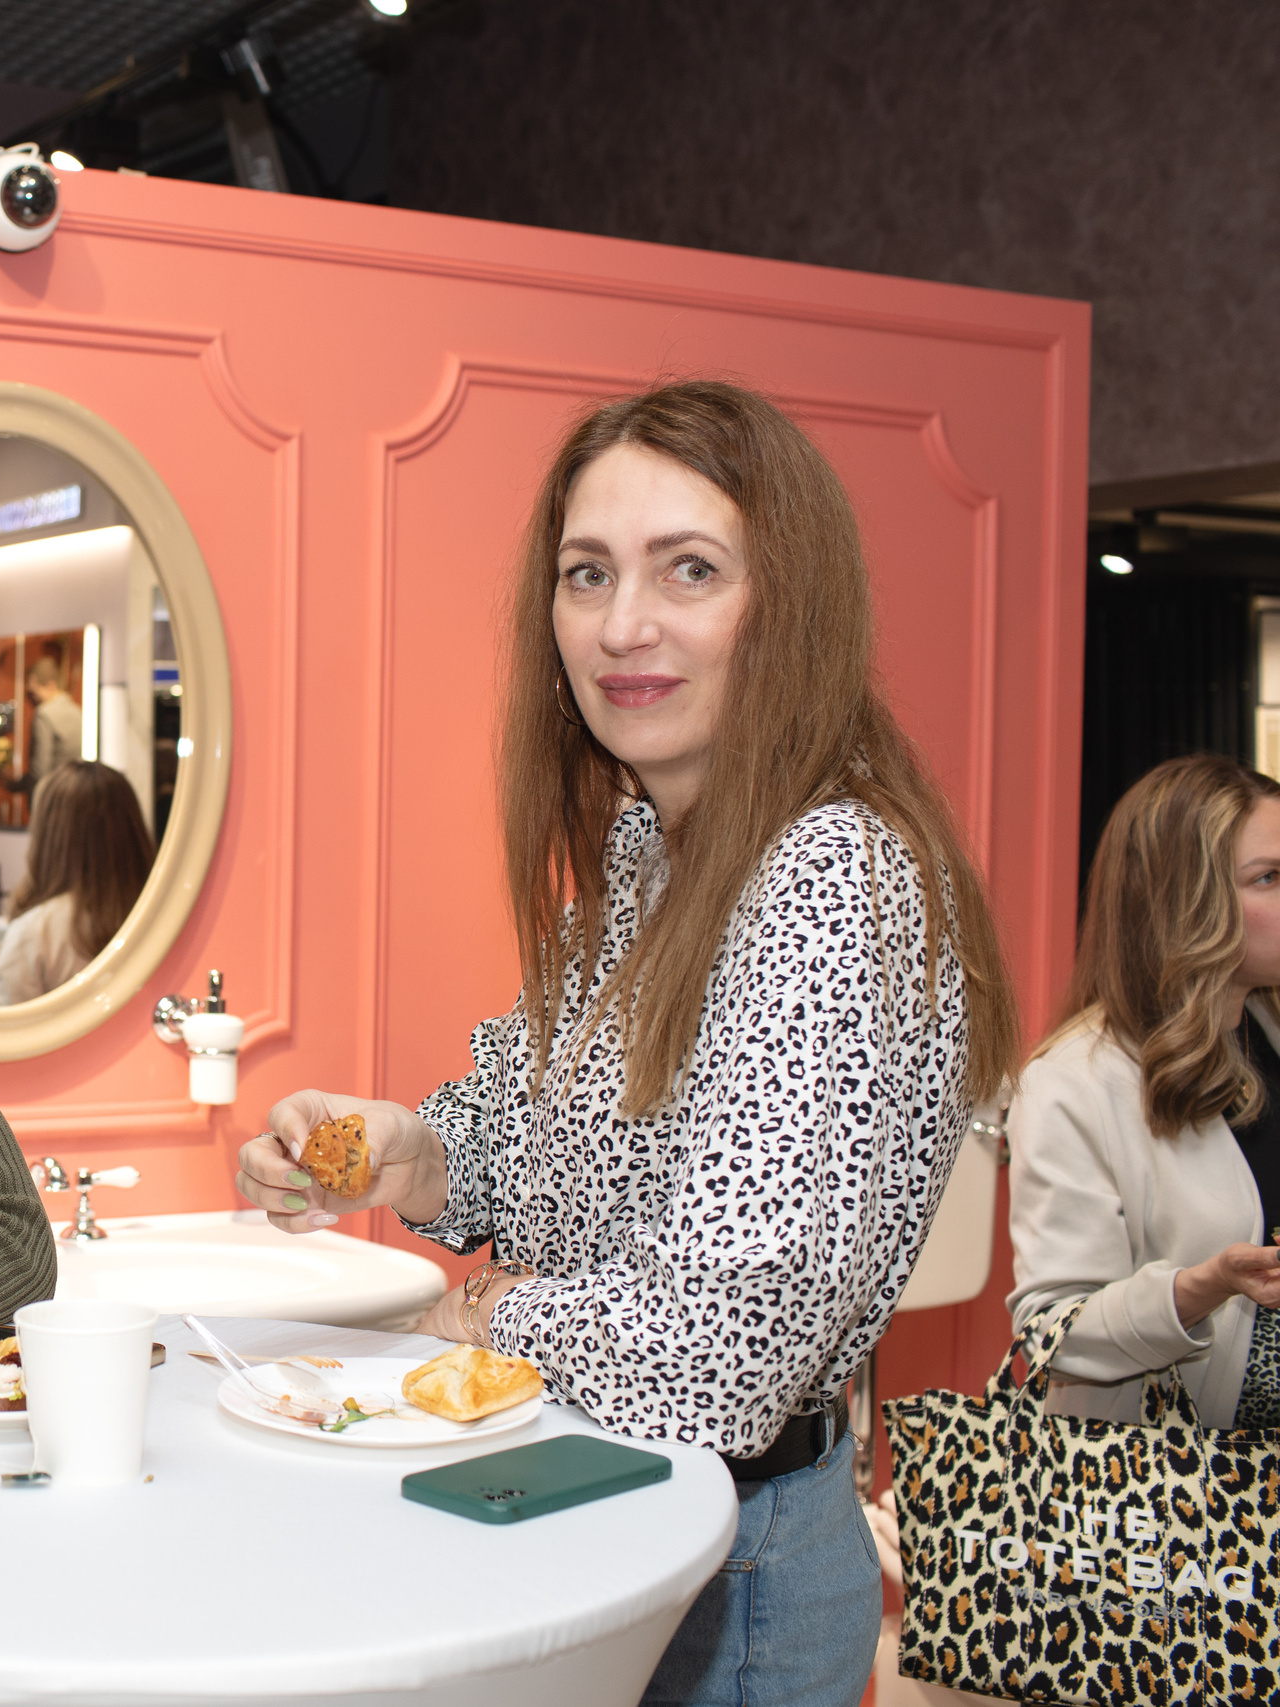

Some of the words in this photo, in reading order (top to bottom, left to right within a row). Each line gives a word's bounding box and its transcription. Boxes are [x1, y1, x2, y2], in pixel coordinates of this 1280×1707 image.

[1049, 1497, 1158, 1542] THE
[954, 1529, 1102, 1584] TOTE
[1126, 1553, 1254, 1601] BAG
[1013, 1584, 1081, 1609] MARC
[1086, 1597, 1187, 1621] JACOBS
